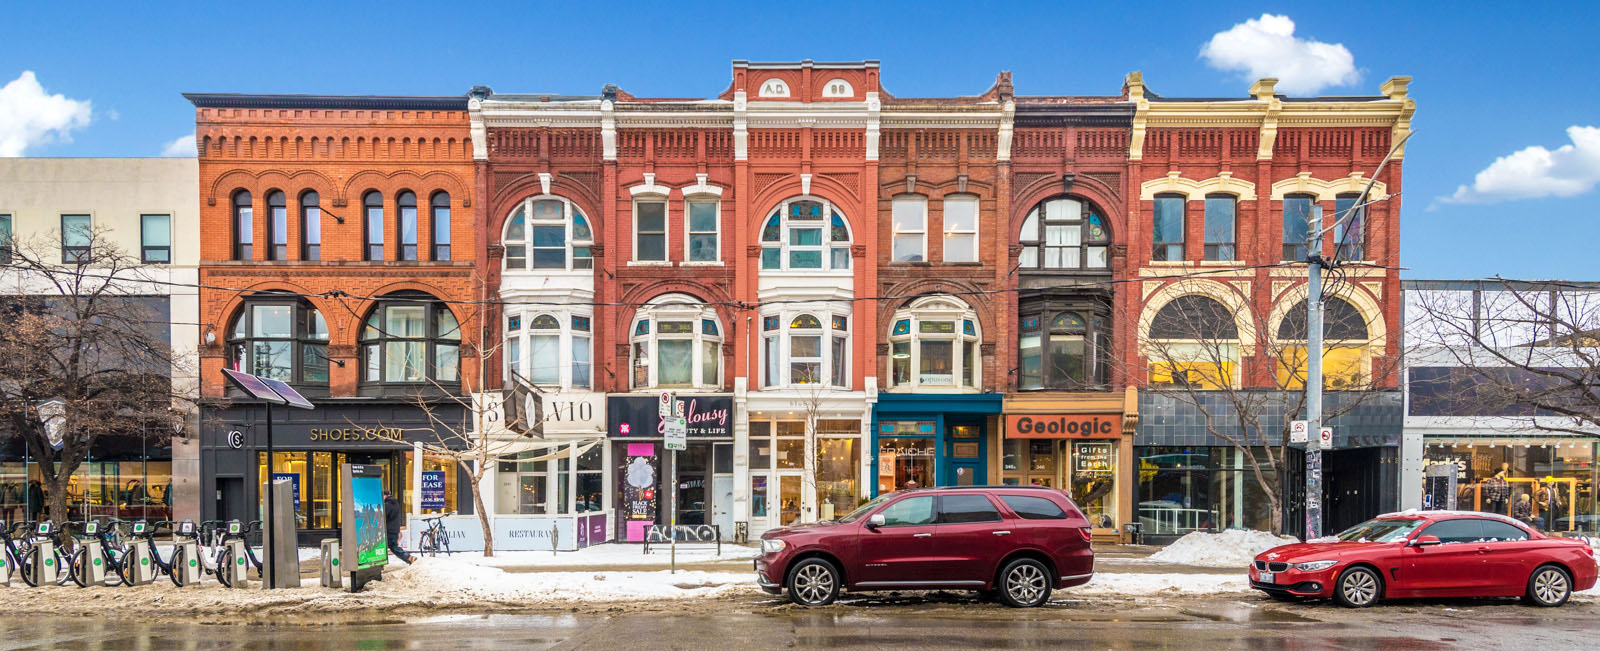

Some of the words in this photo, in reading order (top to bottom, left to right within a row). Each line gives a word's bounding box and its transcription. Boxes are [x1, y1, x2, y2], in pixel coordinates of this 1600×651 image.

[488, 401, 592, 422] SVIO
[310, 428, 402, 441] SHOES.COM
[1017, 417, 1112, 436] Geologic
[509, 530, 554, 538] RESTAURAN
